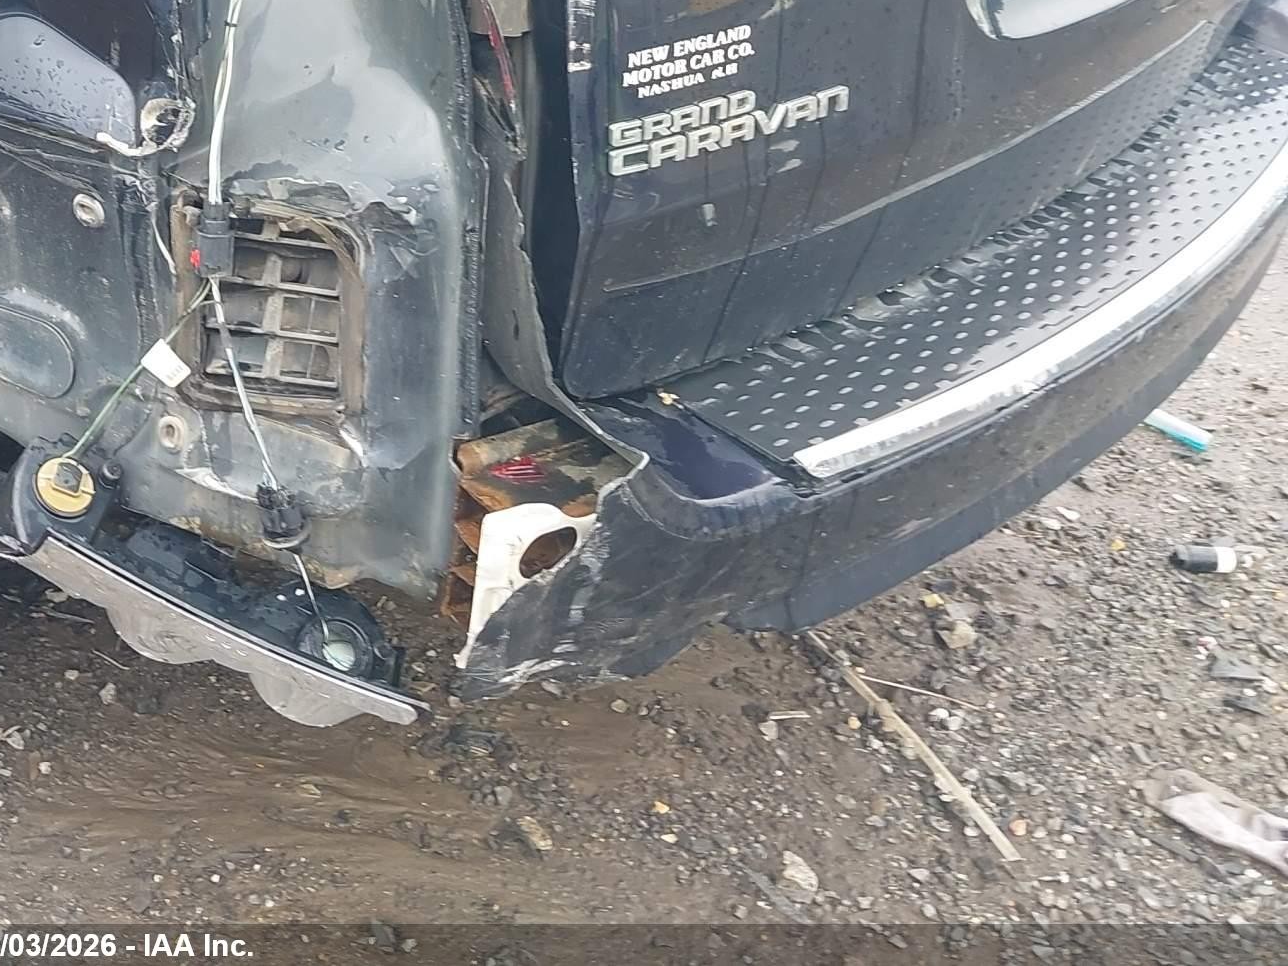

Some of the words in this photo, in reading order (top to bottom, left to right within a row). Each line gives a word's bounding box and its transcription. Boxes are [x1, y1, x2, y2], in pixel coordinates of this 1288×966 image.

[622, 59, 688, 87] MOTOR
[690, 49, 726, 70] CAR
[727, 42, 755, 61] CO.
[628, 45, 670, 68] NEW
[673, 25, 752, 57] ENGLAND
[637, 72, 705, 98] NASHUA
[608, 90, 757, 147] GRAND
[608, 85, 850, 176] CARAVAN
